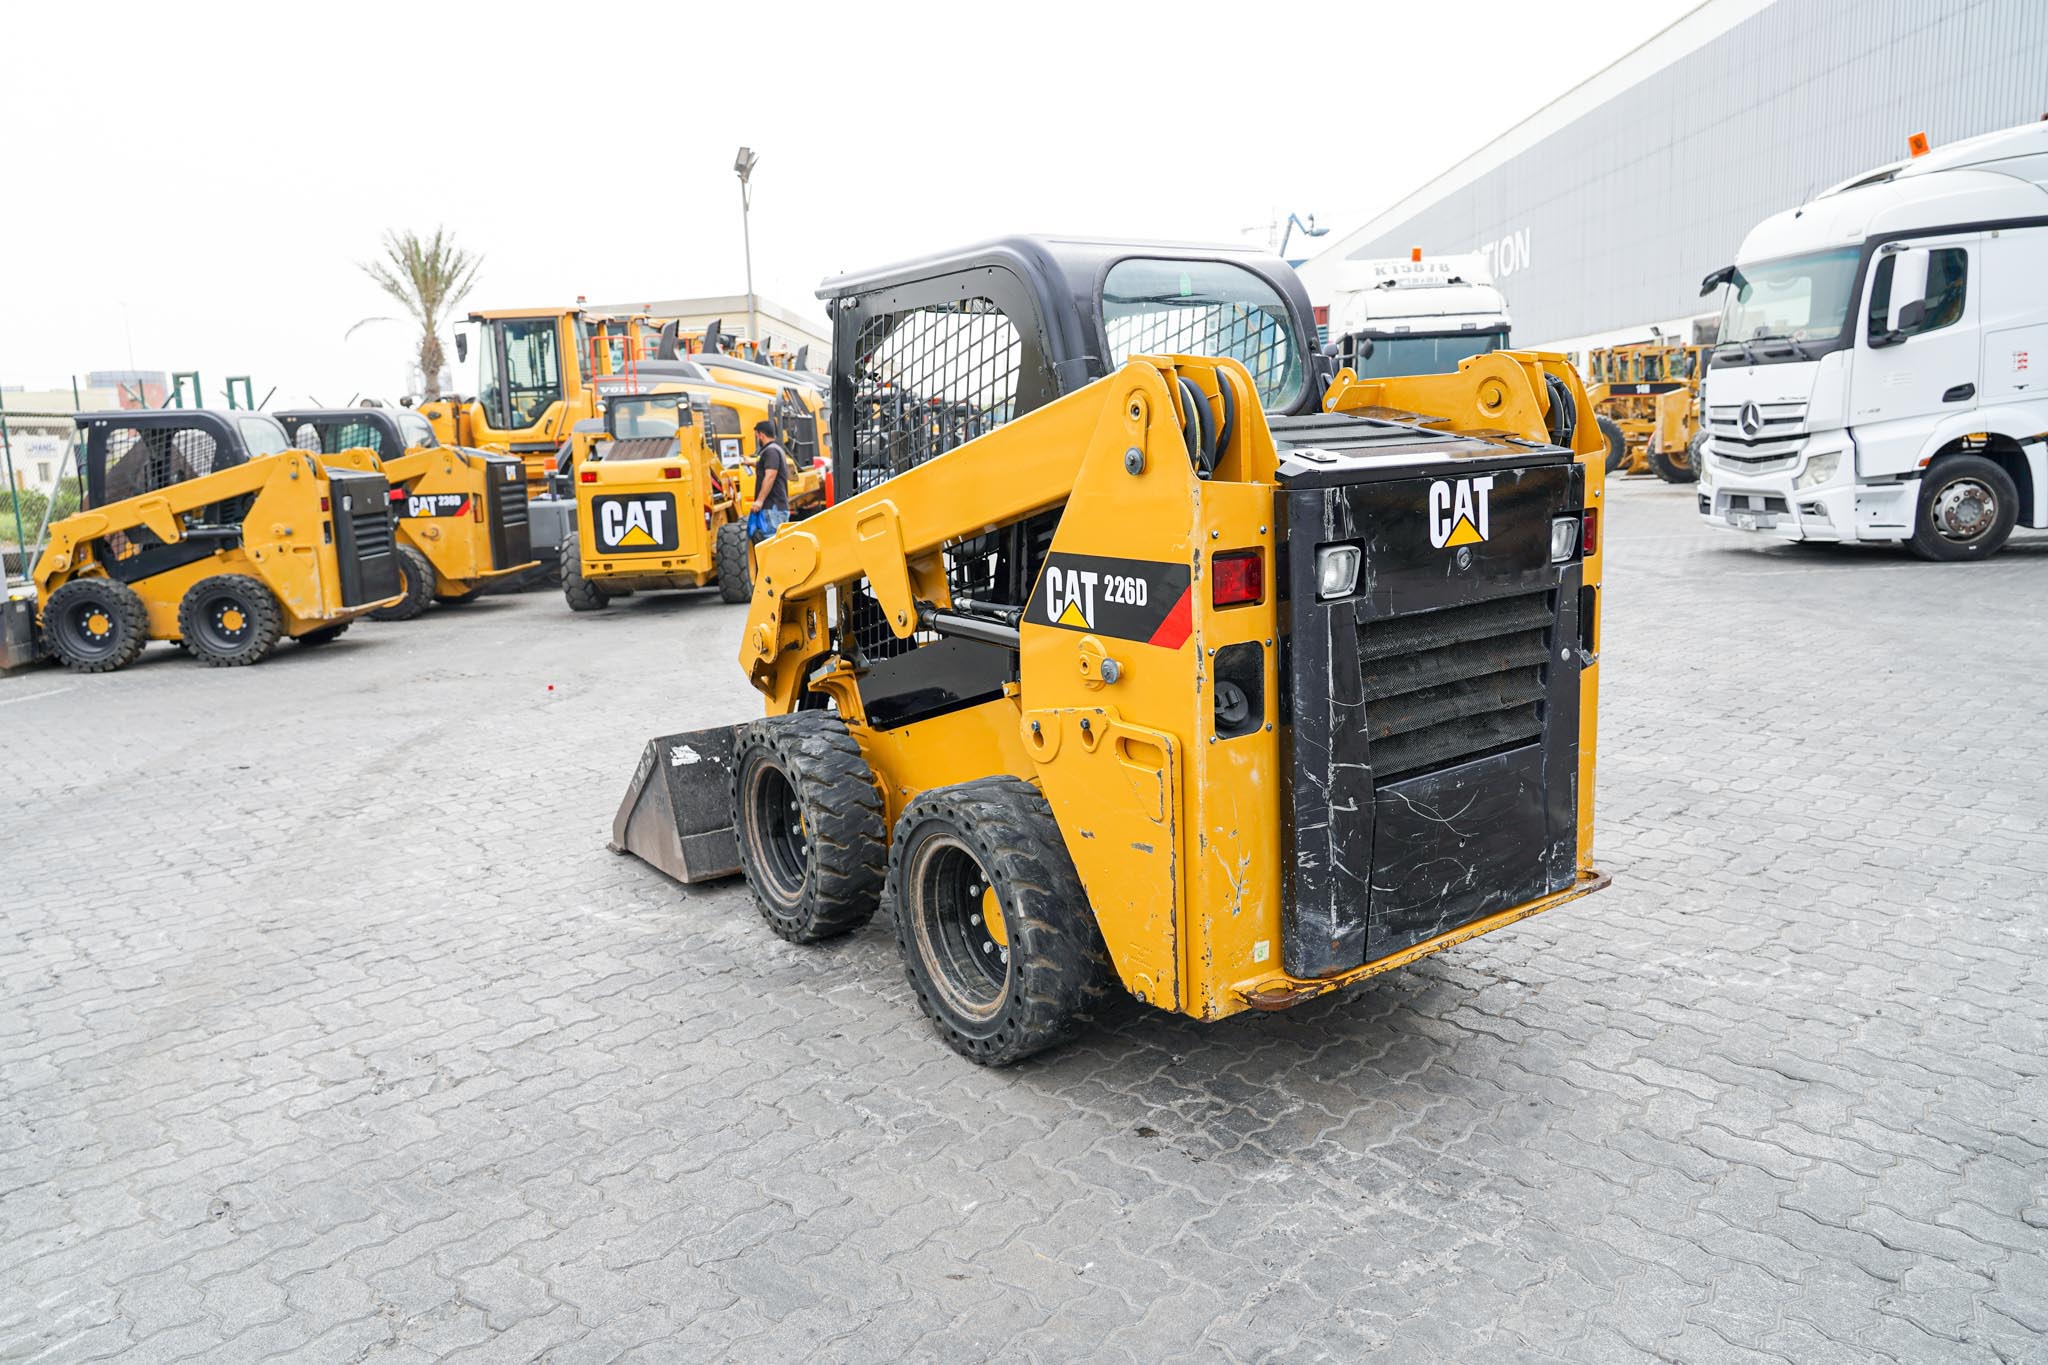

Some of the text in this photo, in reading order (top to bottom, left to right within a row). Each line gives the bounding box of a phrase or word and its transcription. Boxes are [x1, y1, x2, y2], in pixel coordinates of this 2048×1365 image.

[408, 496, 437, 517] CAT
[601, 500, 667, 547] CAT
[1429, 476, 1493, 549] CAT
[1046, 566, 1148, 629] CAT 226D
